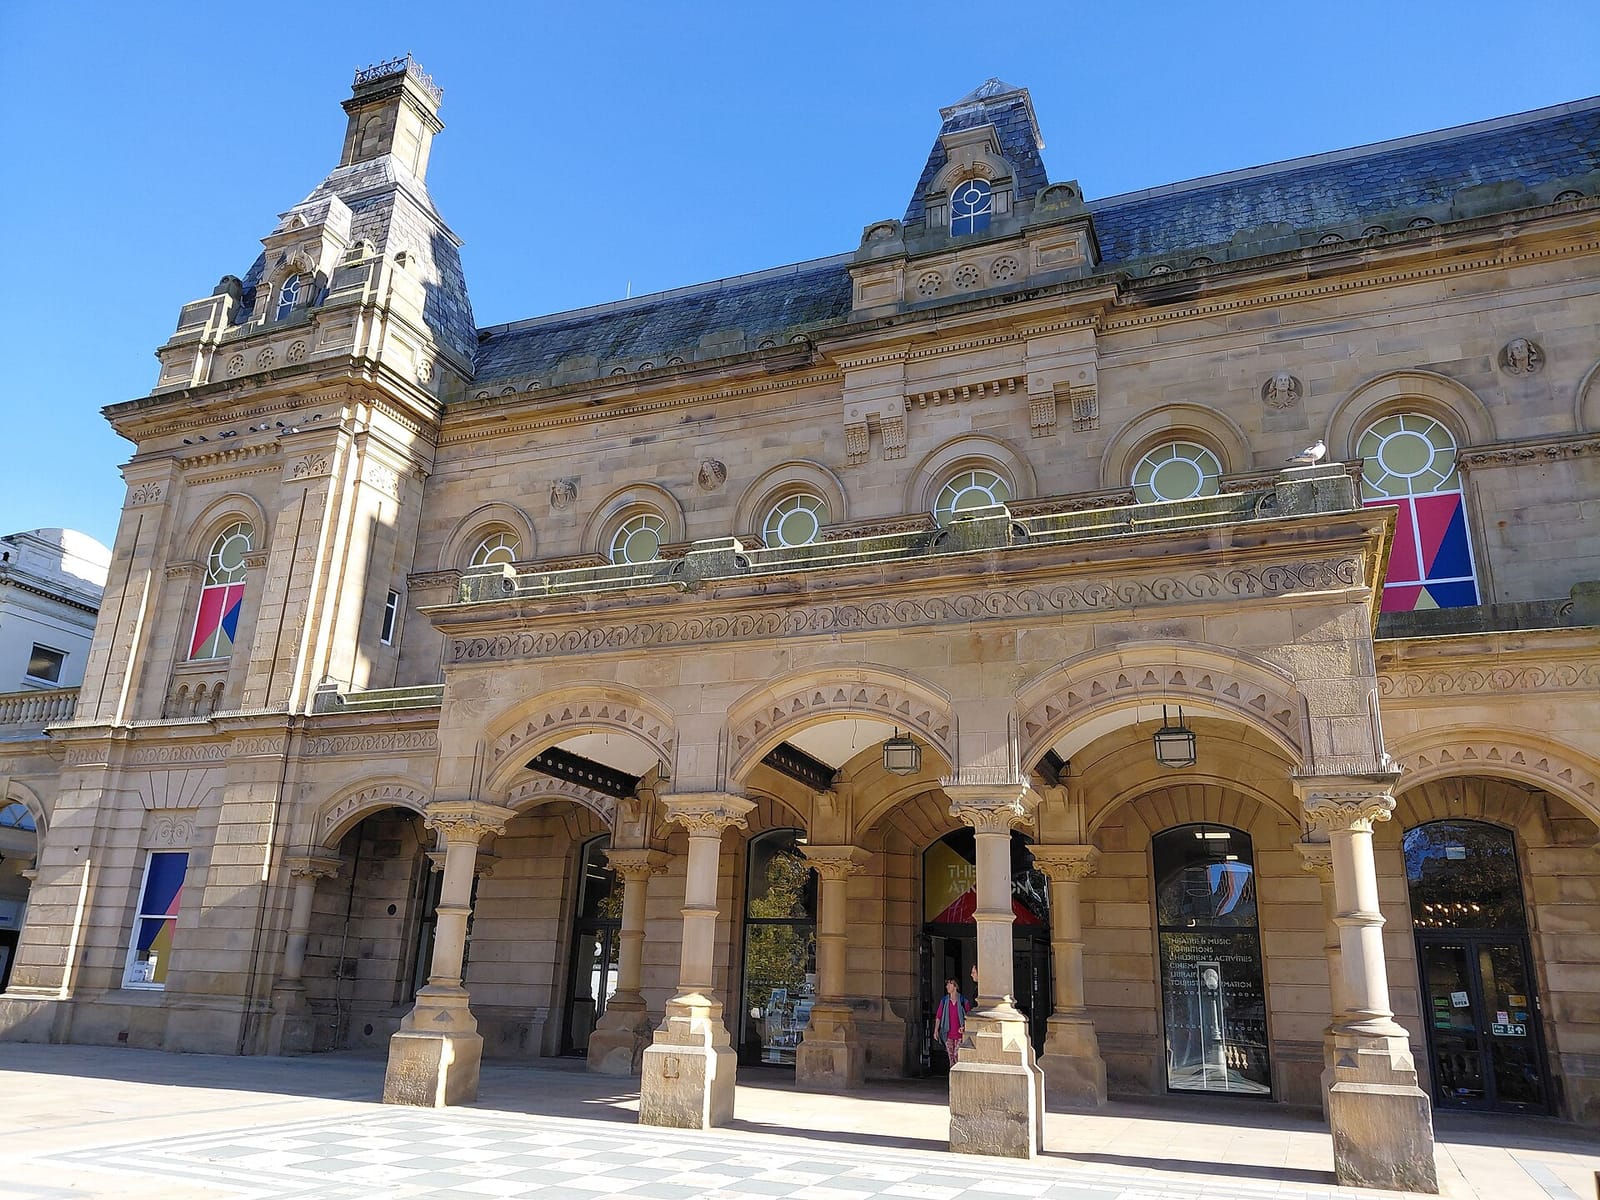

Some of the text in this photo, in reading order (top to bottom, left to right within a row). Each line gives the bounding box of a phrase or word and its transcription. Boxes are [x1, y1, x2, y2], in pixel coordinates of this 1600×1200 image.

[947, 864, 977, 879] THE
[948, 880, 1030, 895] ATKON
[1214, 955, 1253, 963] ACTIVITIES
